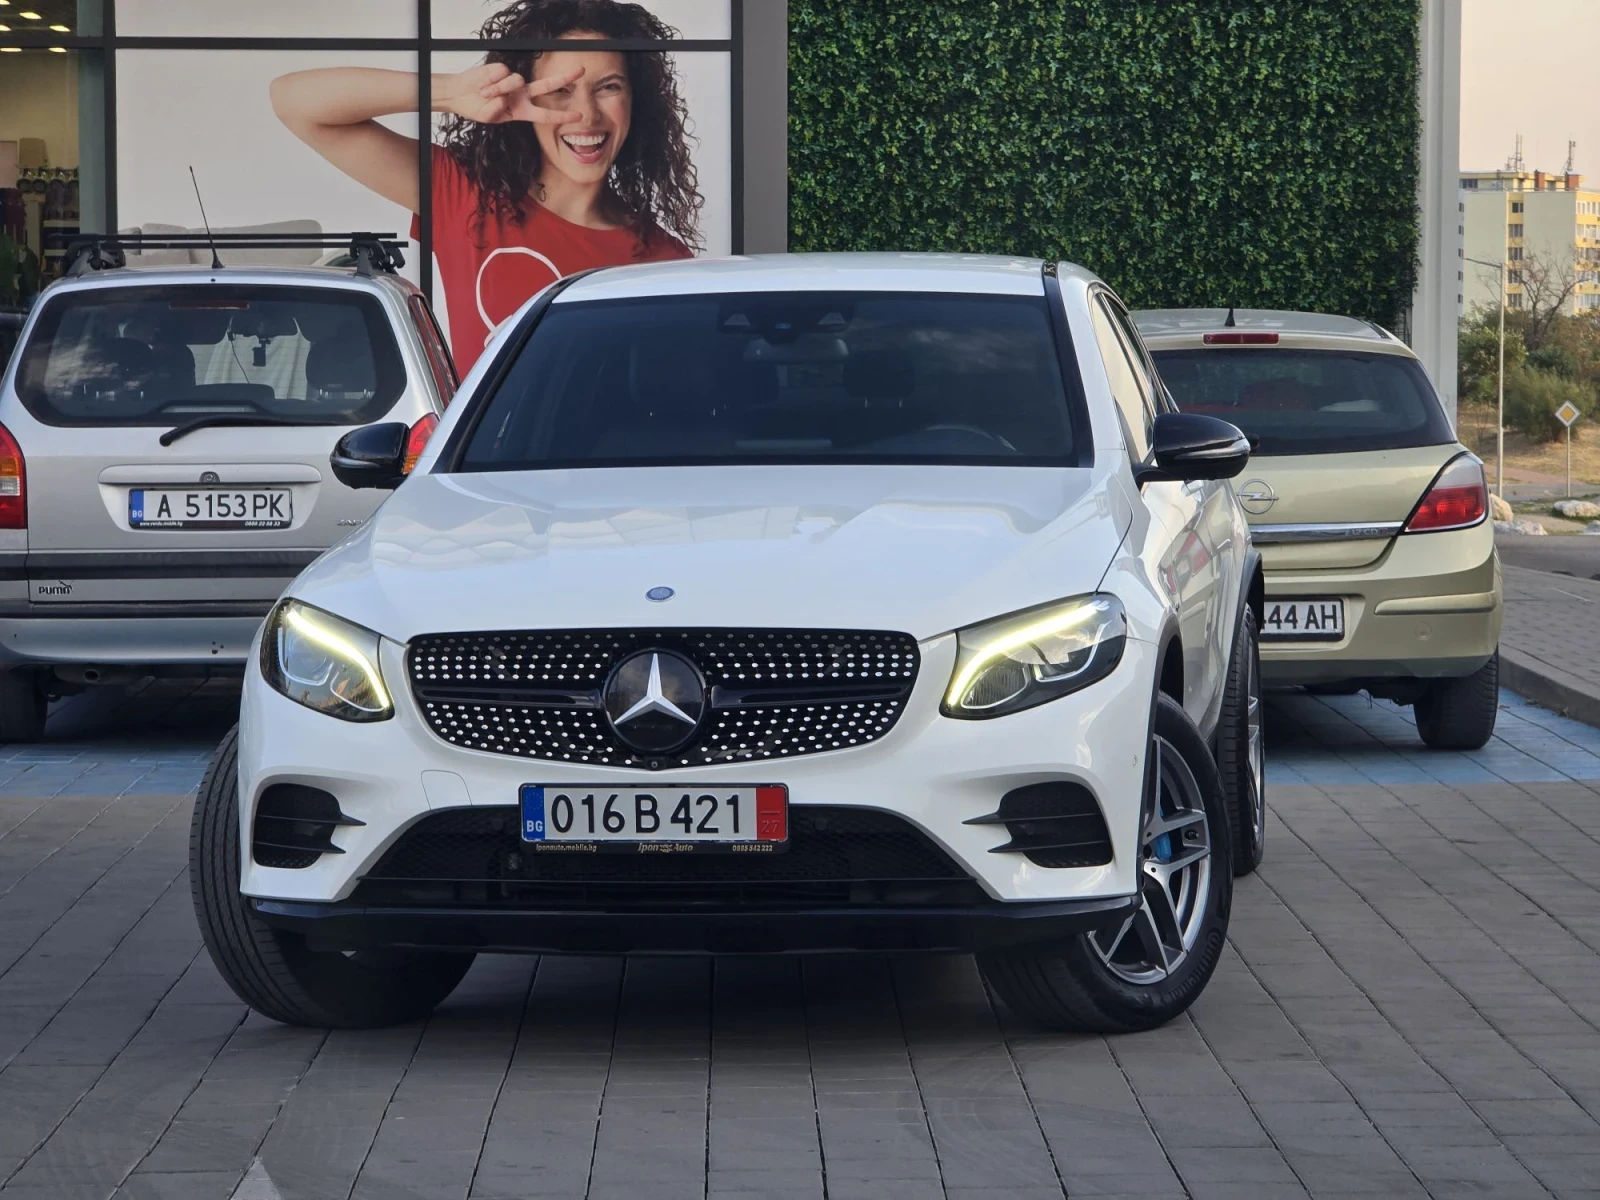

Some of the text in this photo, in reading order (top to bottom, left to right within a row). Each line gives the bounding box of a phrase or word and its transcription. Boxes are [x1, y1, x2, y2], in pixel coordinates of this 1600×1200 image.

[157, 493, 284, 518] A 5153 PK
[131, 509, 143, 518] BG
[1304, 604, 1338, 630] AH
[526, 820, 544, 833] BG
[761, 819, 780, 834] 27
